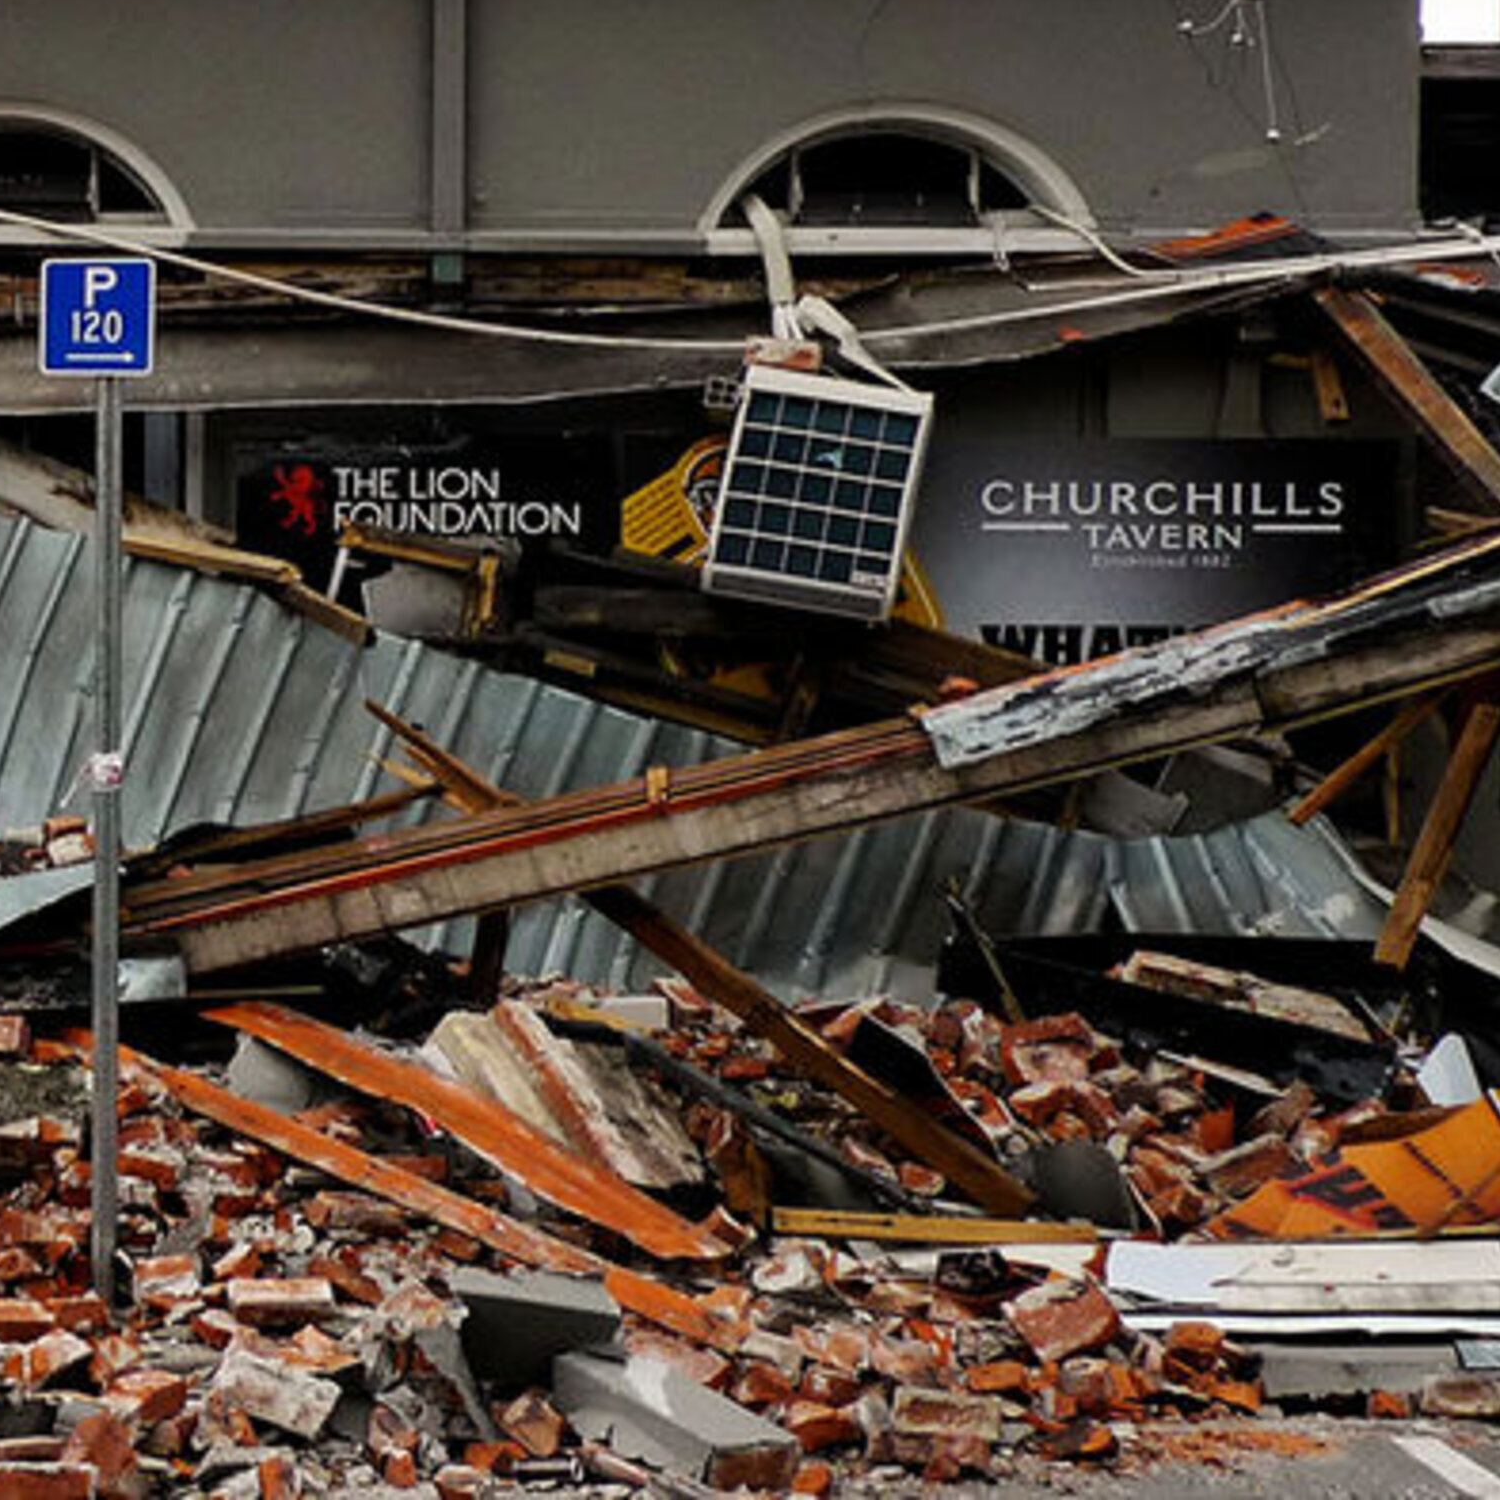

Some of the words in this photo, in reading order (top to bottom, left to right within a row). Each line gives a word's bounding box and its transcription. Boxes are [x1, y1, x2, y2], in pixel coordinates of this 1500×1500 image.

[86, 266, 118, 308] P
[71, 310, 123, 344] 120
[332, 467, 400, 499] THE
[409, 467, 500, 500] LION
[980, 480, 1344, 517] CHURCHILLS
[332, 502, 581, 535] FOUNDATION
[1081, 523, 1243, 550] TAVERN
